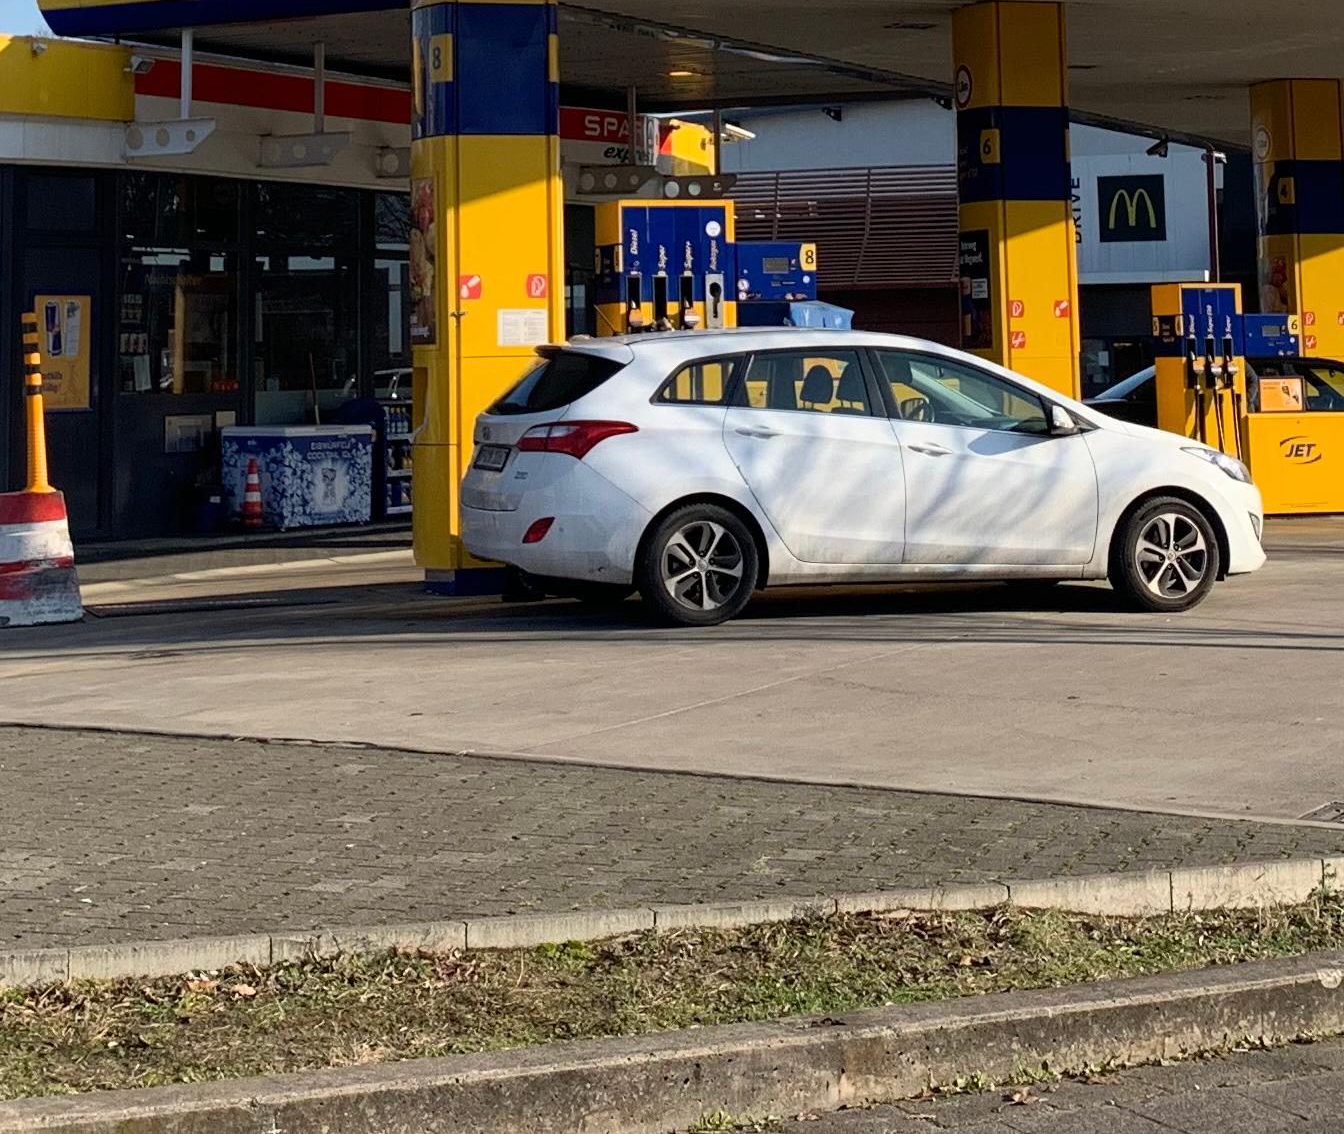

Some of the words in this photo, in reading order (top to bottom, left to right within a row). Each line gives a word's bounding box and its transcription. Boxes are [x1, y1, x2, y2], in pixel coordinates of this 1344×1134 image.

[432, 46, 441, 69] 8
[983, 138, 992, 155] 6
[630, 229, 638, 255] Diesel
[658, 245, 668, 268] Super
[805, 249, 815, 265] 8
[1291, 319, 1298, 330] 6
[1285, 443, 1317, 458] JET
